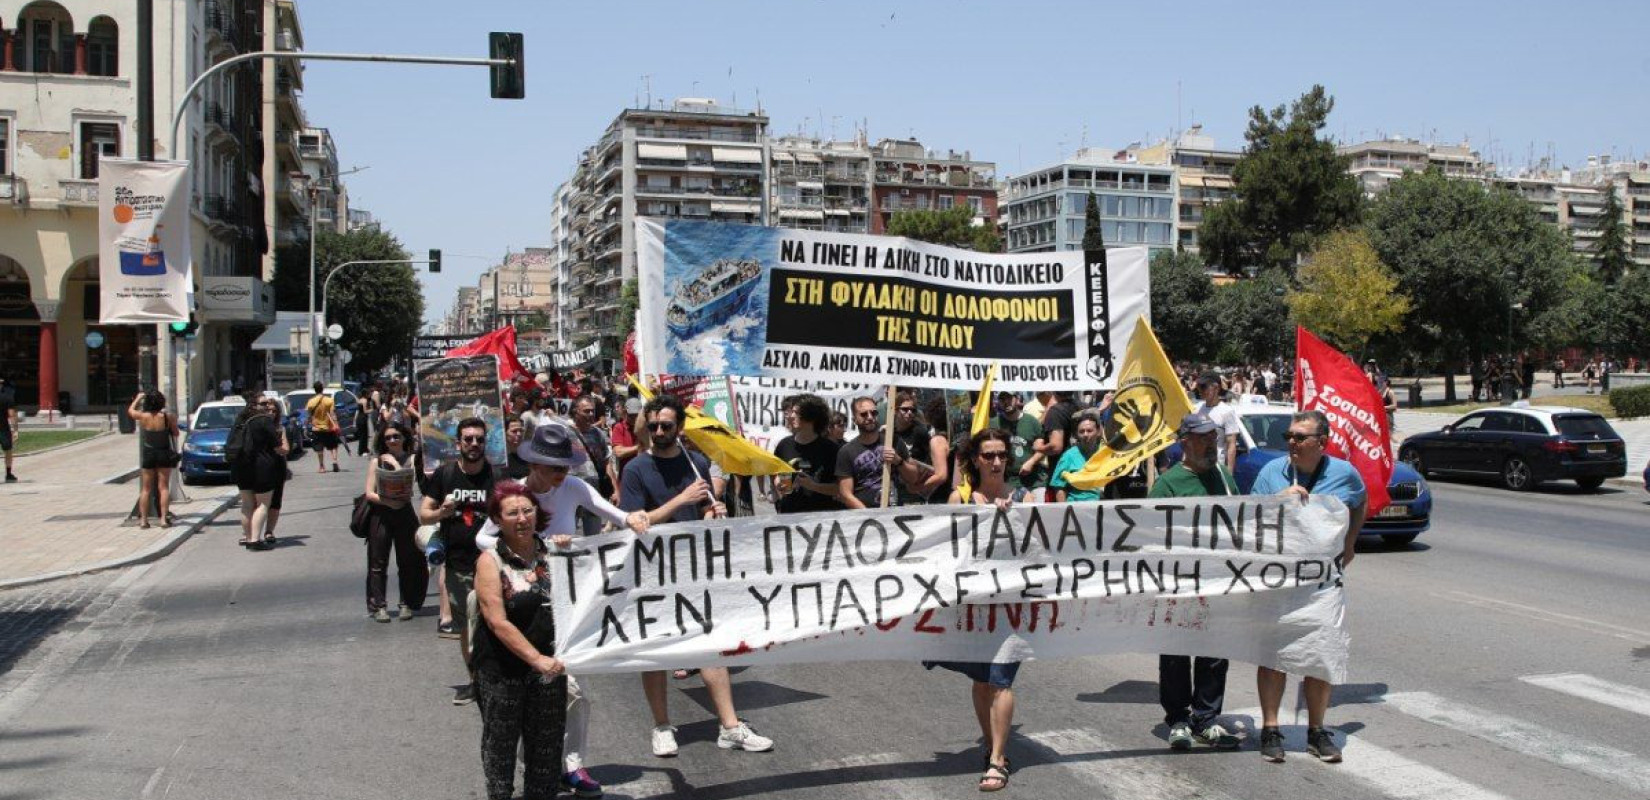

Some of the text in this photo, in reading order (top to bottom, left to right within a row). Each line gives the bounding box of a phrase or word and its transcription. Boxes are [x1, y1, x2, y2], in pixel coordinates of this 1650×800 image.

[780, 239, 1064, 285] ΝΑ ΓΙΝΕΙ Η ΔΙΚΗ ΣΤΟ ΝΑΥΤΟΔΙΚΕΙΟ
[784, 277, 1059, 322] ΣΤΗ ΦΥΛΑΚΗ ΟΙ ΔΟΛΟΦΟΝΟΙ
[1090, 262, 1106, 346] ΚΕΕΡΦΑ
[877, 315, 974, 350] ΤΗΣ ΠΥΛΟΥ
[819, 352, 881, 373] ΑΝΟΙΧΤΑ
[887, 357, 936, 378] ΣΥΝΟΡΑ
[941, 362, 961, 380] ΓΙΑ
[1002, 364, 1078, 381] ΠΡΟΣΦΥΓΕΣ
[452, 488, 486, 502] OPEN
[763, 515, 928, 575] ΠΥΛΟΣ
[951, 502, 1284, 559] ΠΑΛΑΙΣΤΙΝΗ
[748, 568, 1001, 631] ΥΠΑΡΧΕΙ
[1020, 558, 1200, 599] ΕΙΡΗΝΗ
